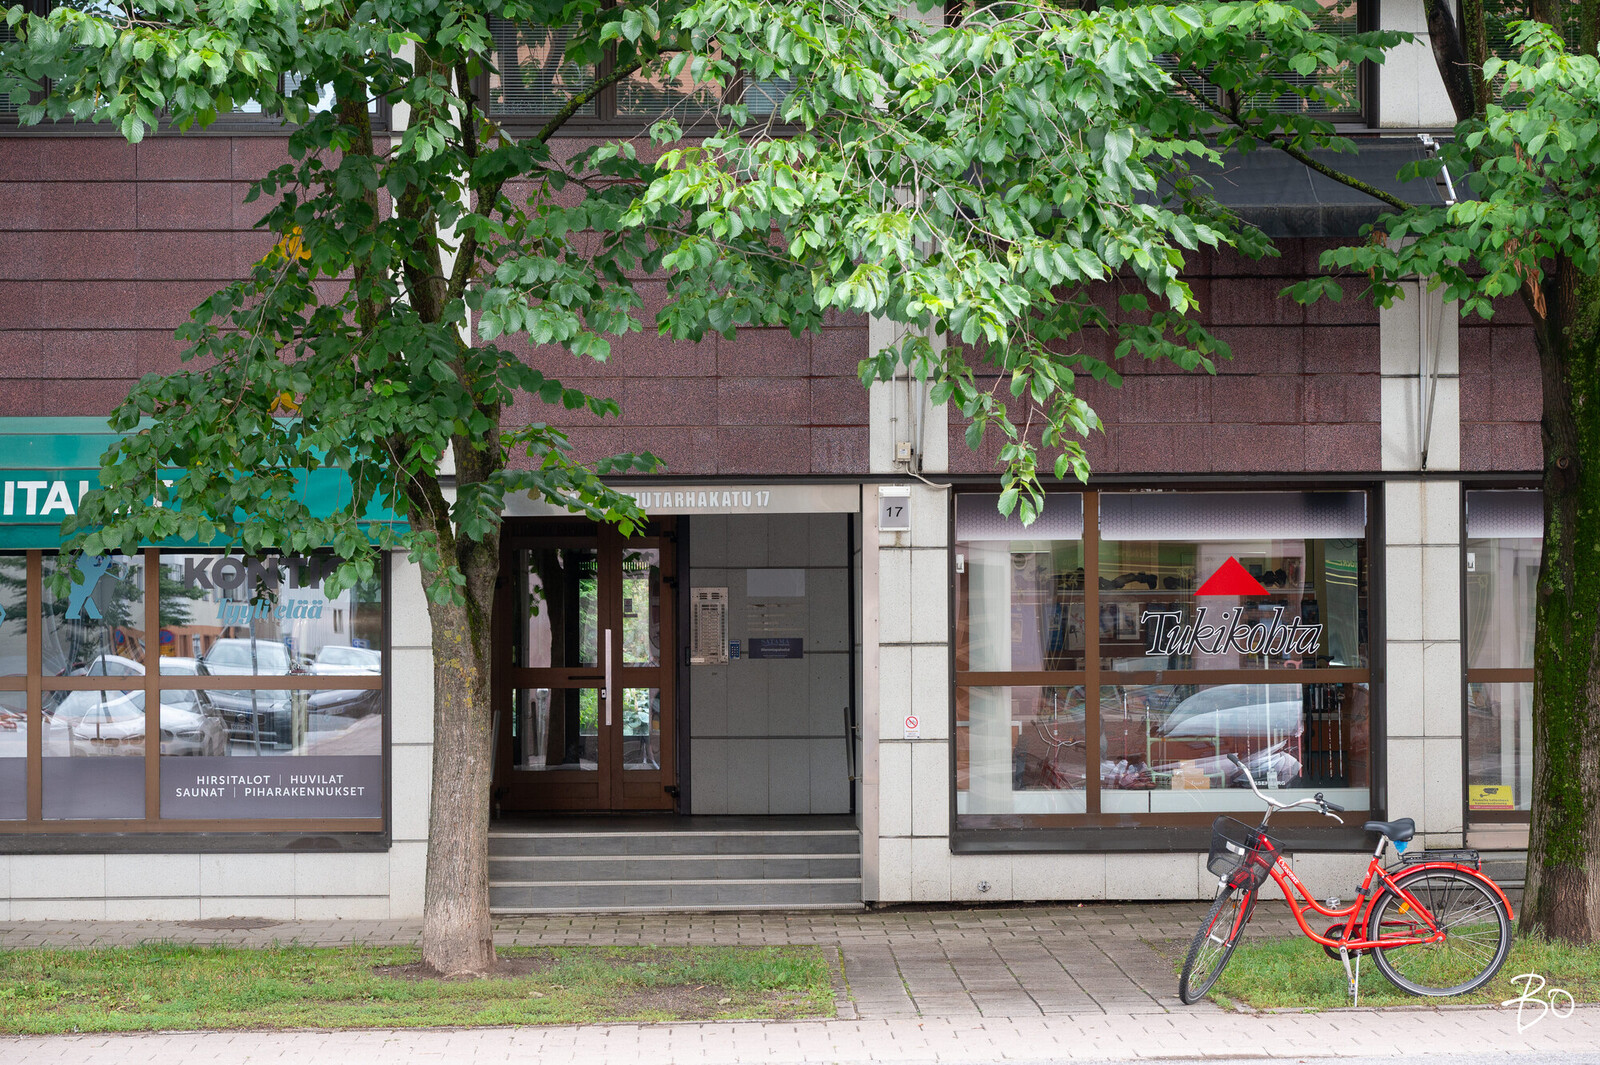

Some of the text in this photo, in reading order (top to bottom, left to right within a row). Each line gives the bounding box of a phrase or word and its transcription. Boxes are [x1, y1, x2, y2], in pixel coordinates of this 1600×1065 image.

[620, 490, 751, 508] UUTARHAKATU
[754, 490, 770, 507] 17
[886, 506, 903, 517] 17
[215, 598, 323, 625] Tyyli elää
[1141, 606, 1323, 656] Tukikohta
[196, 774, 344, 785] HIRSITALOT HUVILAT
[175, 786, 365, 797] SAUNAT PIHARAKENNUKSET
